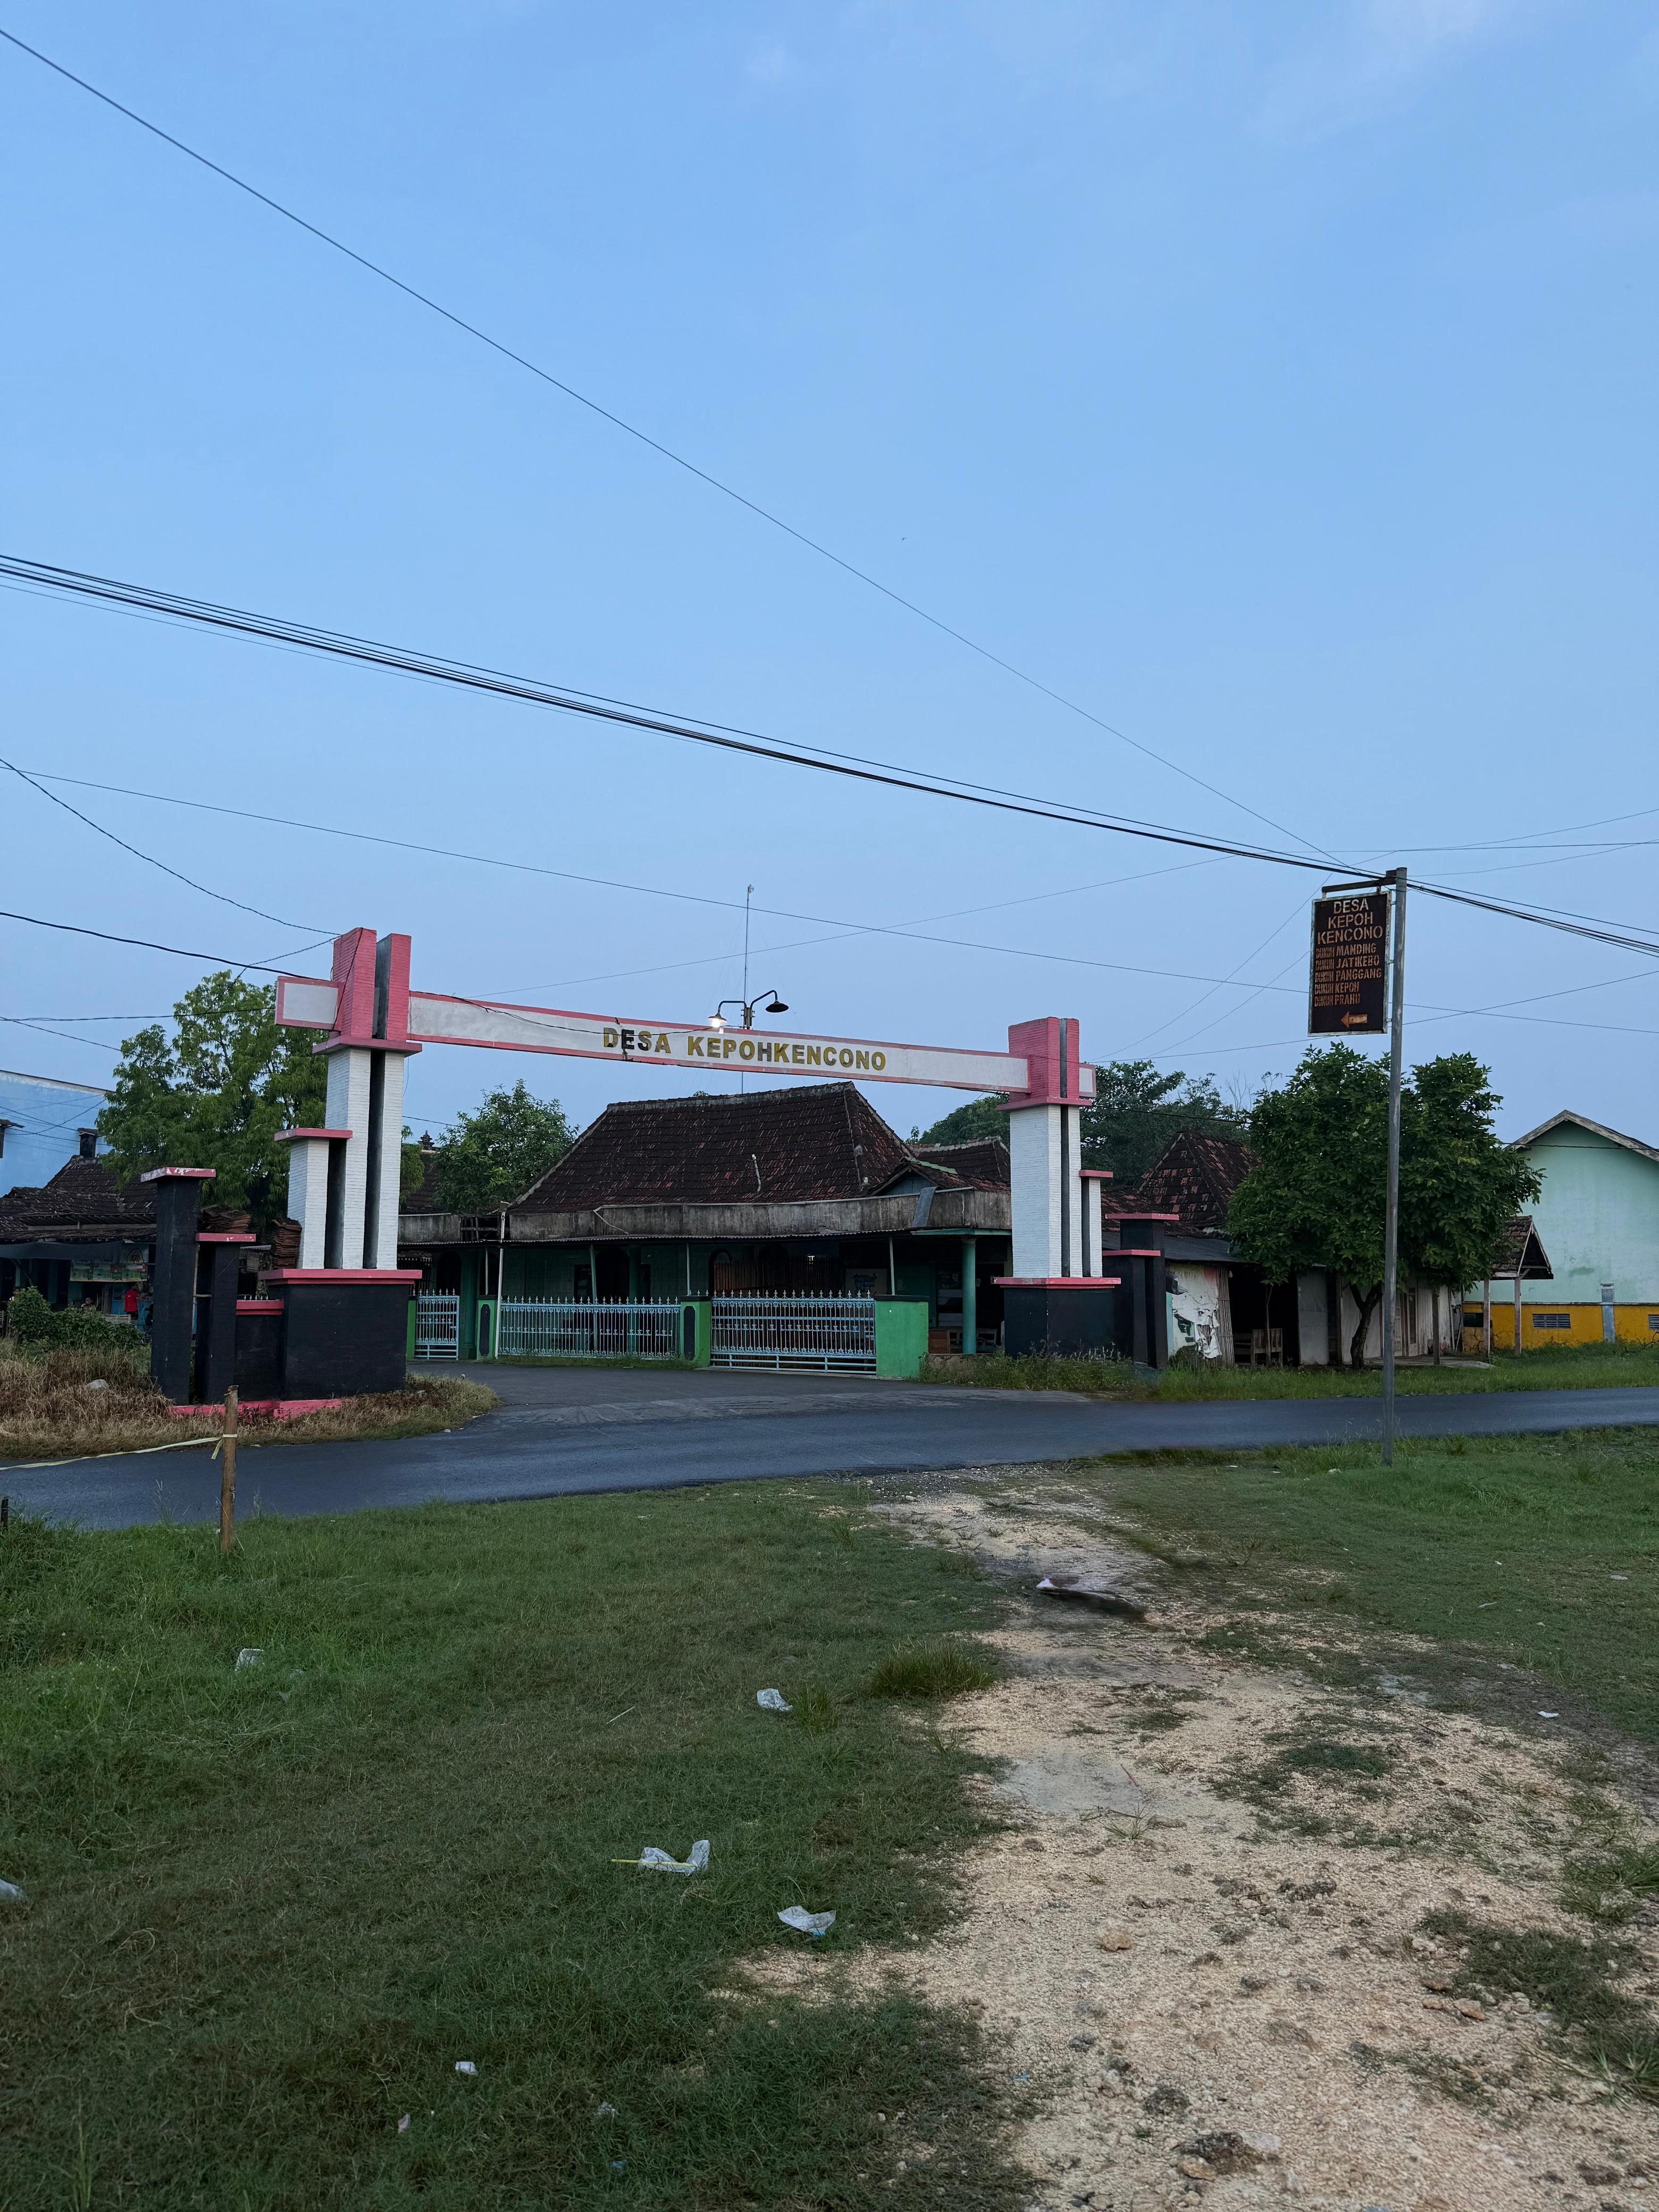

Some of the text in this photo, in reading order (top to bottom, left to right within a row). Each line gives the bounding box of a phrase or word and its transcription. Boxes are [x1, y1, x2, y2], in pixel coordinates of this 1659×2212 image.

[1334, 898, 1369, 914] DESA
[1328, 912, 1373, 929] KEPOH
[1317, 925, 1383, 945] KENCONO
[1316, 943, 1376, 959] DUKUH MANDING
[1316, 959, 1334, 971] DUKUH
[1315, 968, 1382, 983] DUKUH PANGGANG
[1314, 982, 1360, 995] DUKUH KEPOH
[1314, 993, 1361, 1007] DUKUH PRAHU
[604, 1027, 886, 1071] DESA KEPOHKENCONO
